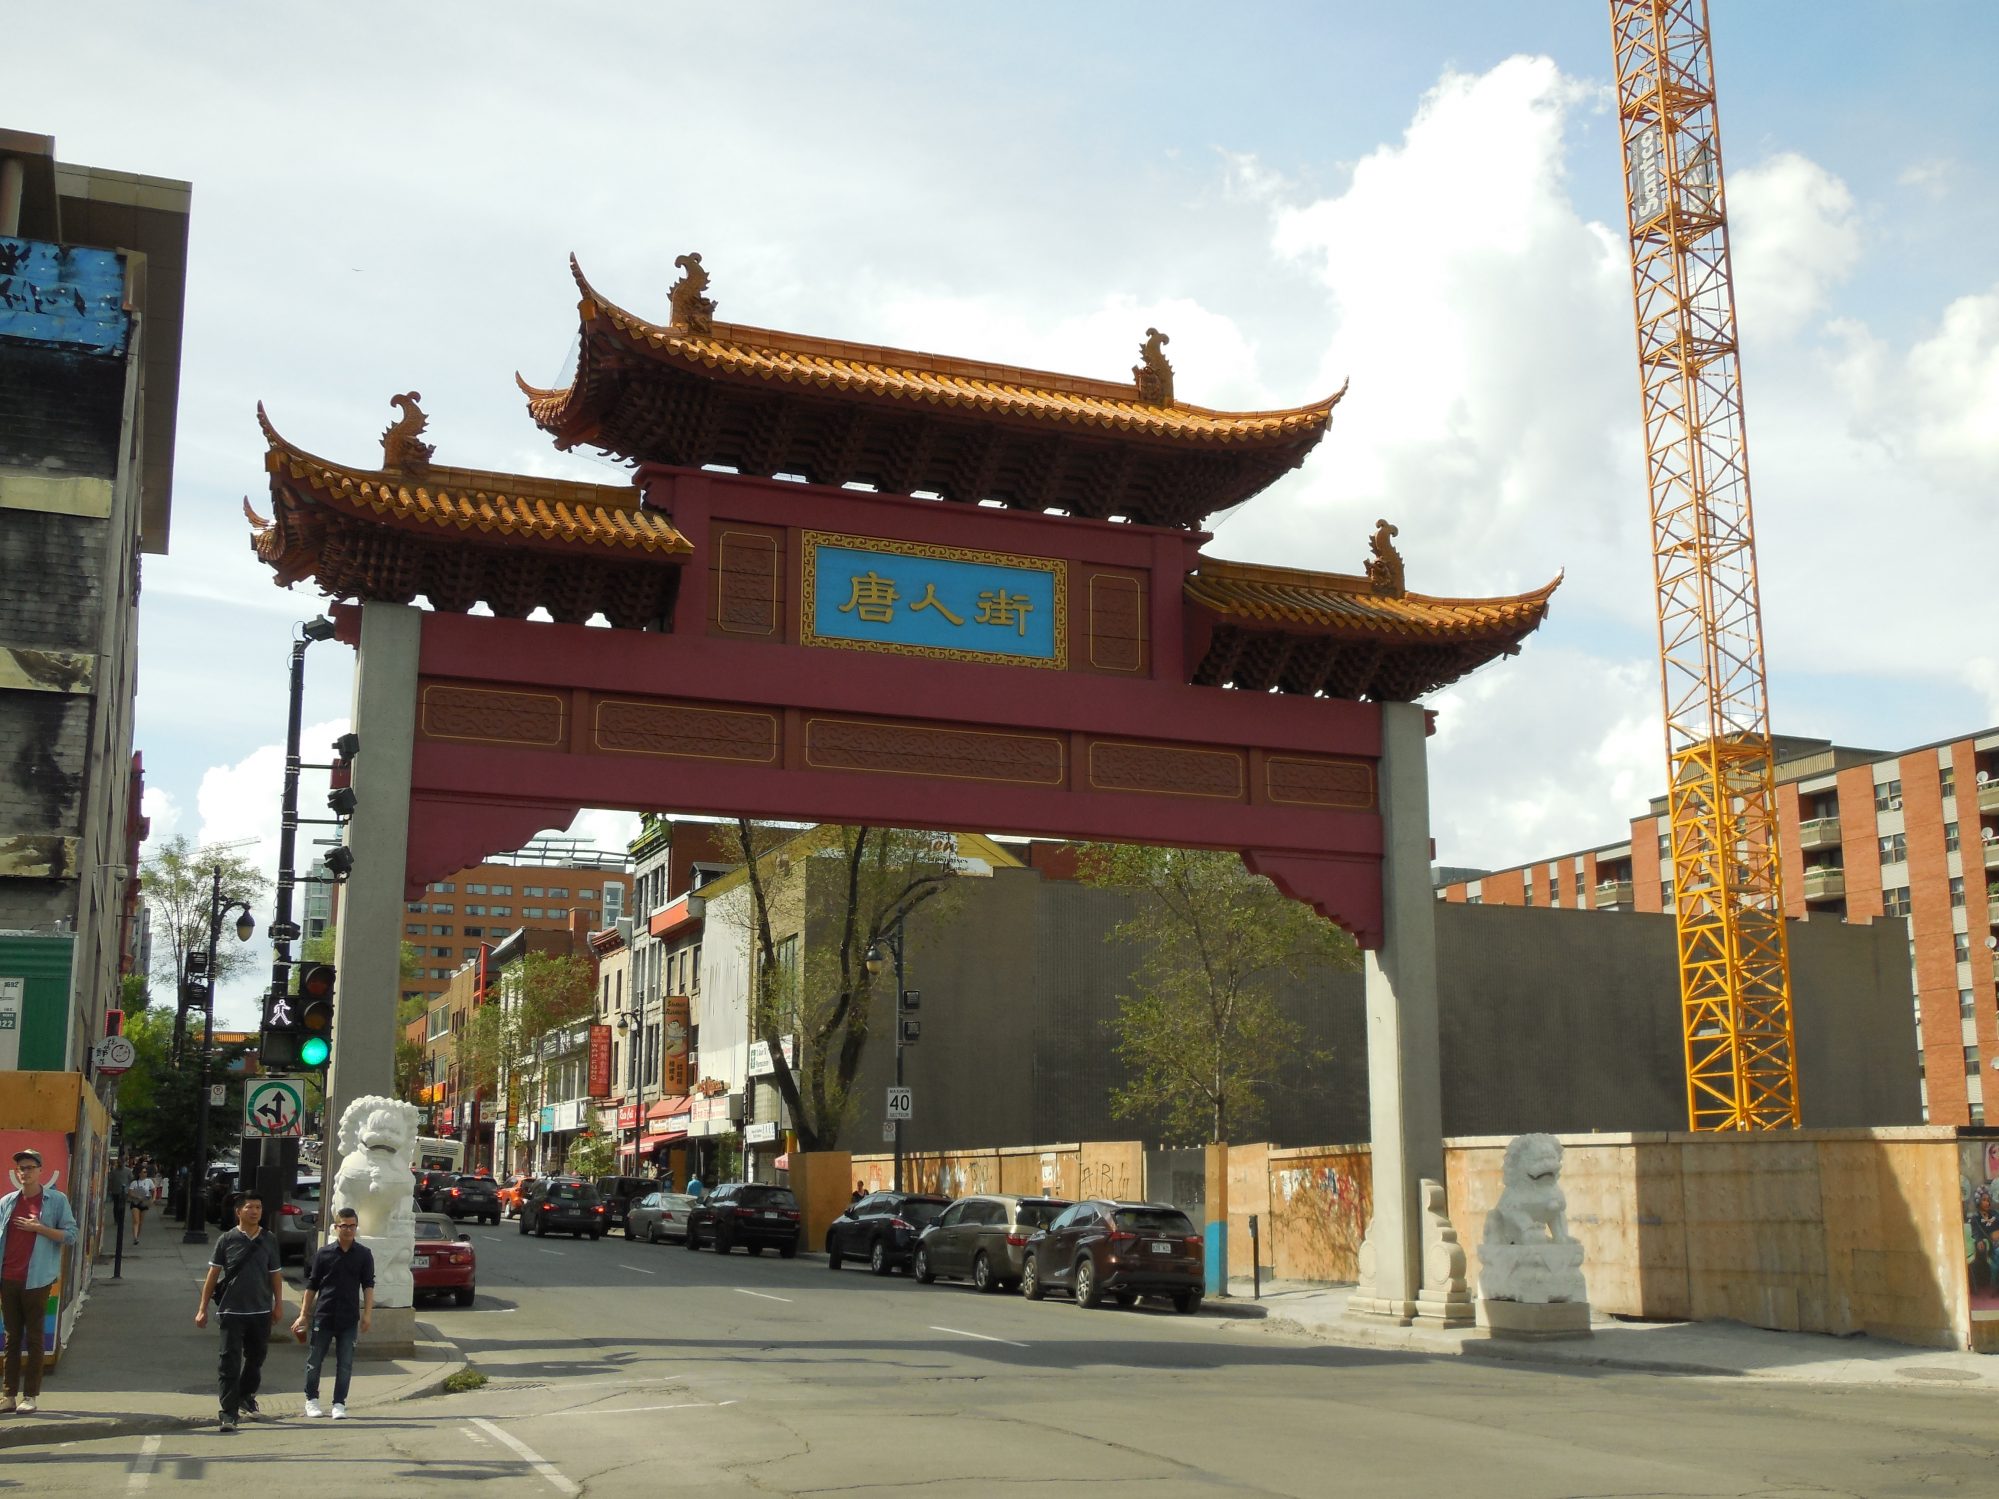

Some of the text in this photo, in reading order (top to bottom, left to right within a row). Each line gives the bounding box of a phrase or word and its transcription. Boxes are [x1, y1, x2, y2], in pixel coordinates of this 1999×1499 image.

[1638, 130, 1659, 217] santco
[838, 571, 1034, 637] 唐人街
[889, 1094, 910, 1111] 40
